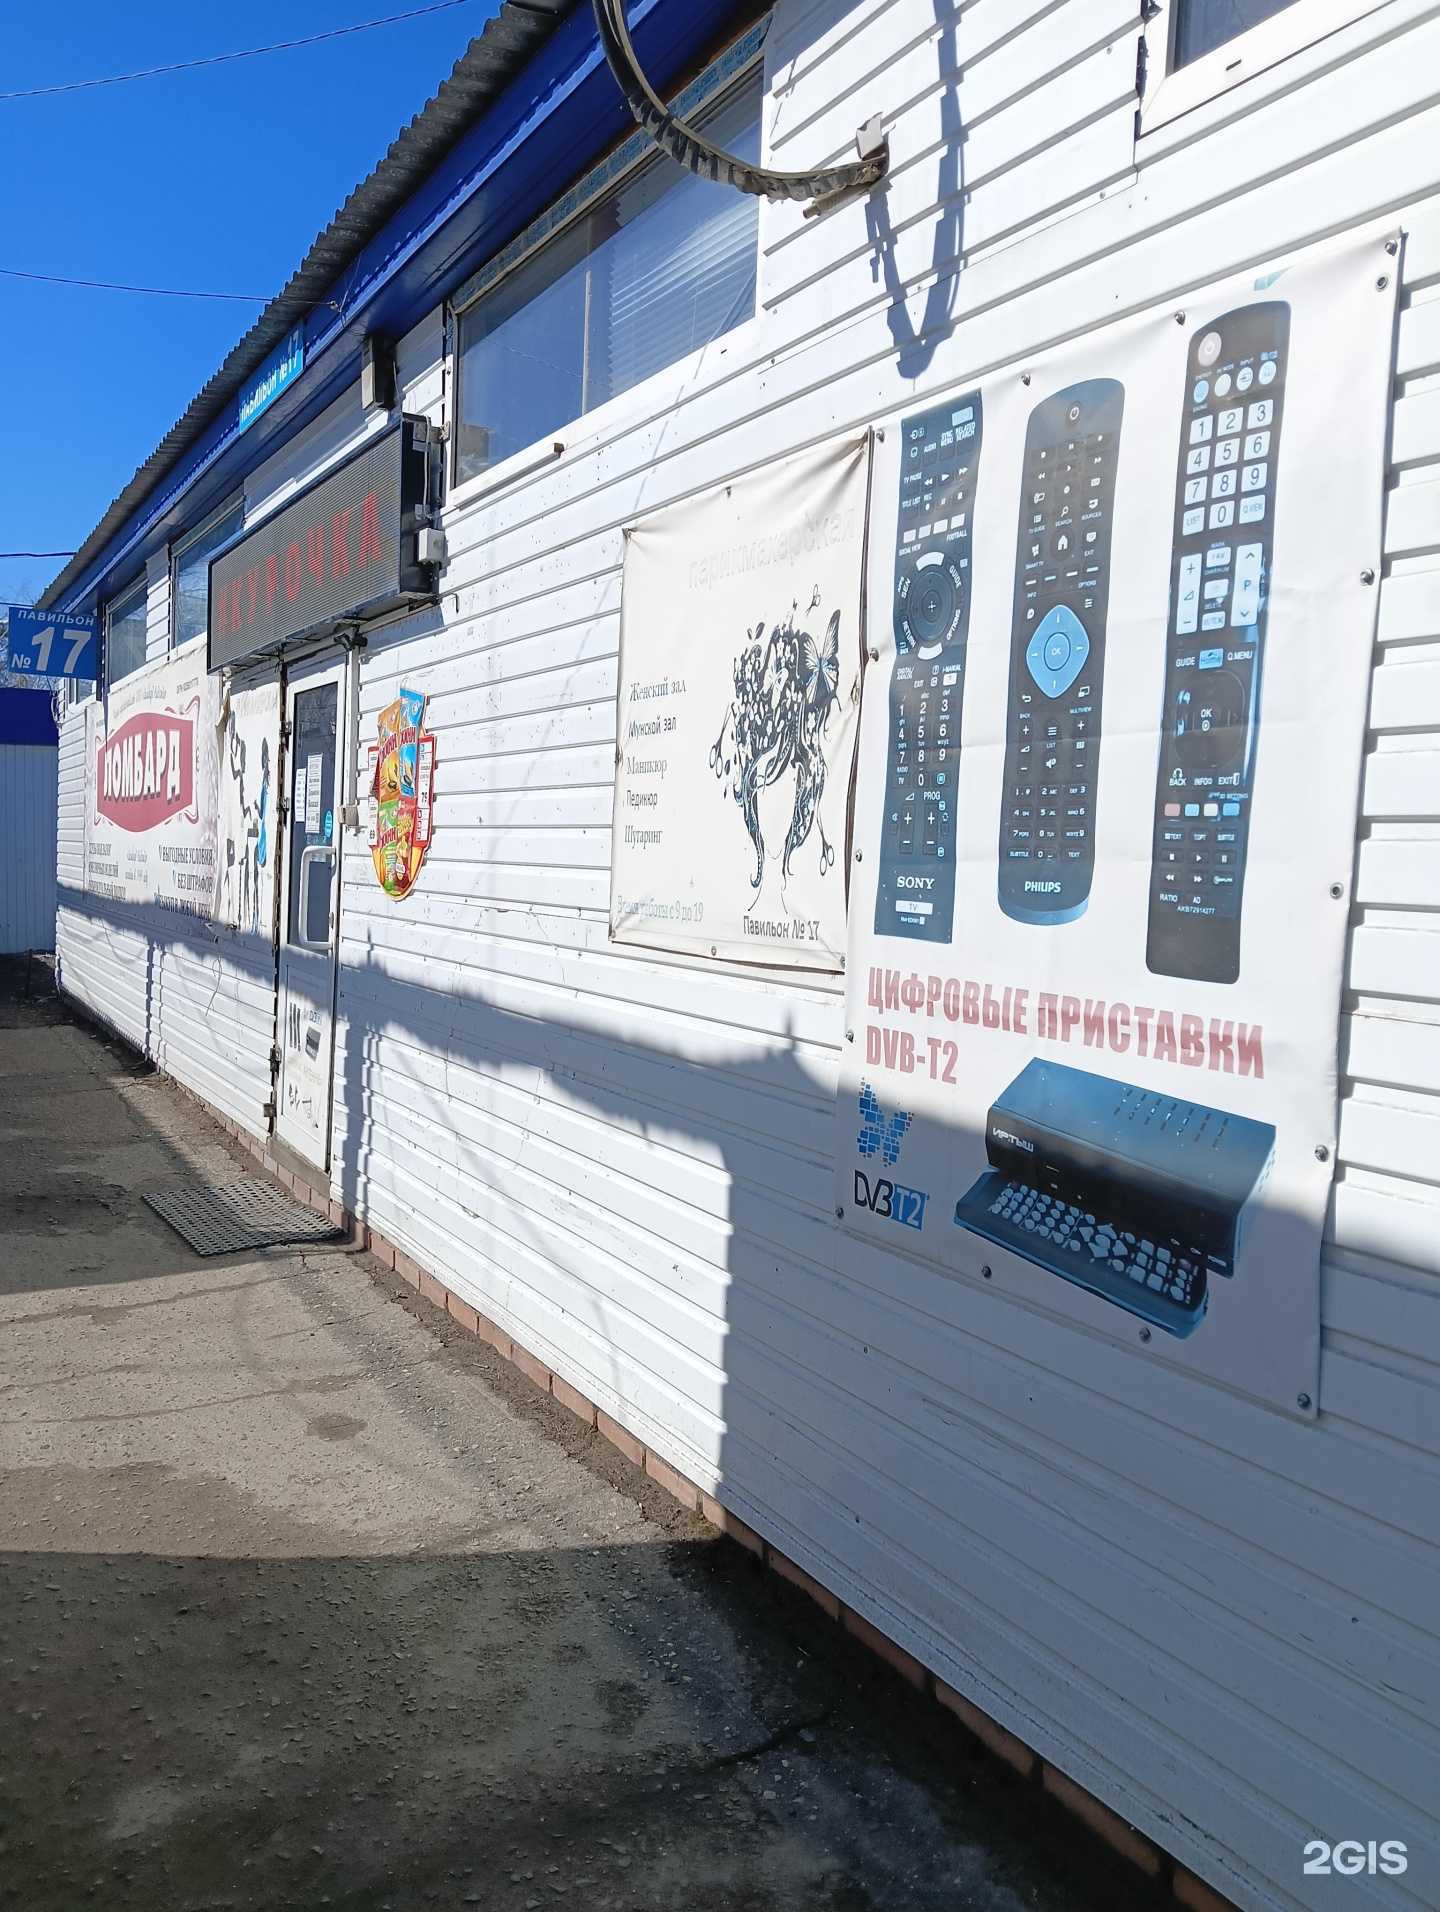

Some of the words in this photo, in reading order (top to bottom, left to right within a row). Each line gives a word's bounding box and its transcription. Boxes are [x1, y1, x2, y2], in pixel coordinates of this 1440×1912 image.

[1199, 421, 1204, 437] 1
[1226, 412, 1235, 430] 2
[1257, 404, 1266, 422] 3
[1194, 451, 1202, 467] 4
[1223, 443, 1231, 460] 5
[1253, 436, 1262, 453] 6
[1193, 481, 1200, 499] 7
[1220, 474, 1229, 492] 8
[1250, 467, 1260, 486] 9
[1217, 505, 1226, 523] 0
[18, 610, 95, 626] ПАВИЛЬОН
[11, 653, 31, 669] №
[32, 627, 92, 674] 17
[1227, 651, 1252, 661] Q.MENU
[1176, 656, 1195, 667] GUIDE
[629, 676, 669, 702] Женский
[671, 679, 687, 696] зал
[920, 702, 927, 714] 2
[941, 699, 948, 712] 3
[1201, 709, 1212, 718] OK
[628, 715, 661, 741] Мужской
[663, 716, 677, 731] зал
[918, 726, 924, 738] 5
[940, 724, 946, 736] 6
[918, 750, 925, 762] 8
[939, 749, 945, 761] 9
[104, 730, 181, 804] ЛОМБАРД
[626, 757, 667, 779] Маникюр
[1169, 778, 1187, 786] BACK
[626, 789, 658, 810] Педикюр
[923, 791, 940, 800] PROG
[624, 825, 663, 850] Шугаринг
[897, 876, 935, 889] SONY
[1024, 881, 1061, 893] PHILIPS
[1160, 894, 1178, 902] RATIO
[743, 916, 790, 938] Павильон
[808, 920, 820, 940] 17
[867, 965, 1030, 1036] ЦИФРОВЫЕ
[1038, 991, 1265, 1079] ПРИСТАВКИ
[866, 1025, 960, 1084] DVB-T2
[992, 1127, 1034, 1152] ИРТЫШ
